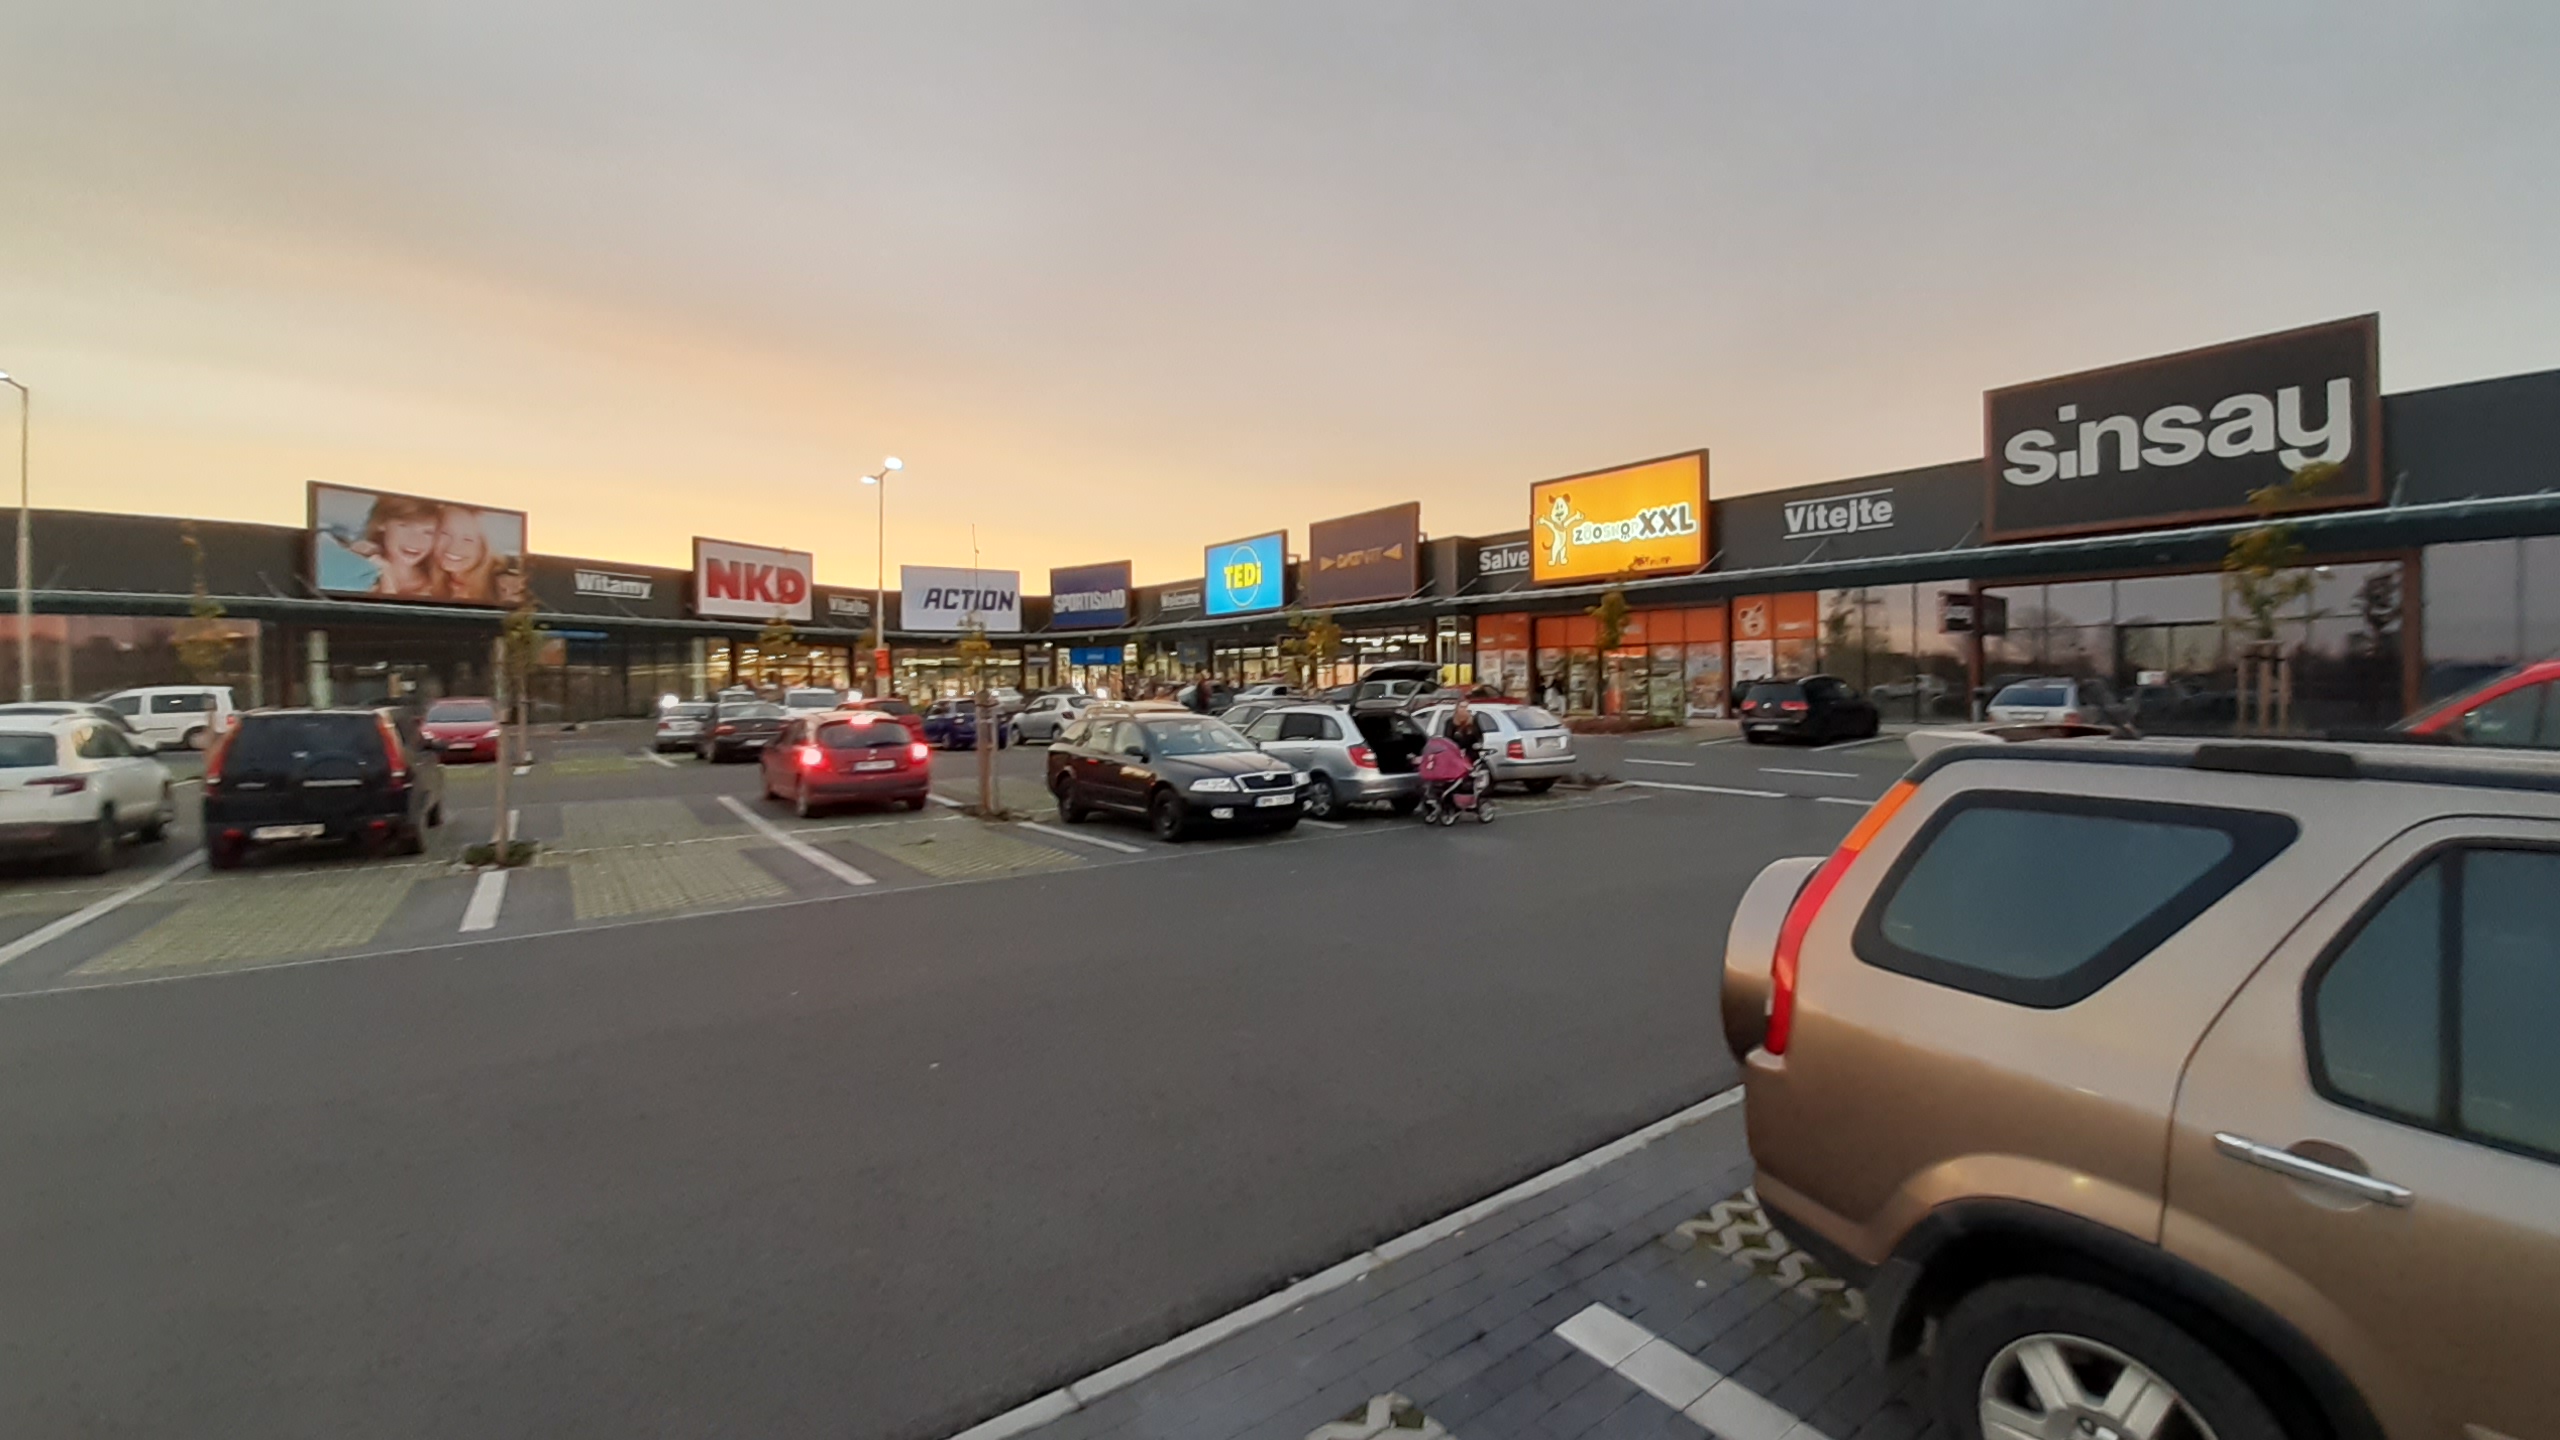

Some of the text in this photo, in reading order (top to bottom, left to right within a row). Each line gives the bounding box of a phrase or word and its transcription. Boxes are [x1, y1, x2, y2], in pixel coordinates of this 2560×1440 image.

[2003, 377, 2352, 486] sinsay
[1784, 498, 1893, 534] Vítejte
[1479, 548, 1530, 572] Salve
[574, 573, 652, 599] Witamy
[706, 558, 806, 605] NKD
[1224, 561, 1262, 590] TEDi
[923, 588, 1015, 612] ACTION
